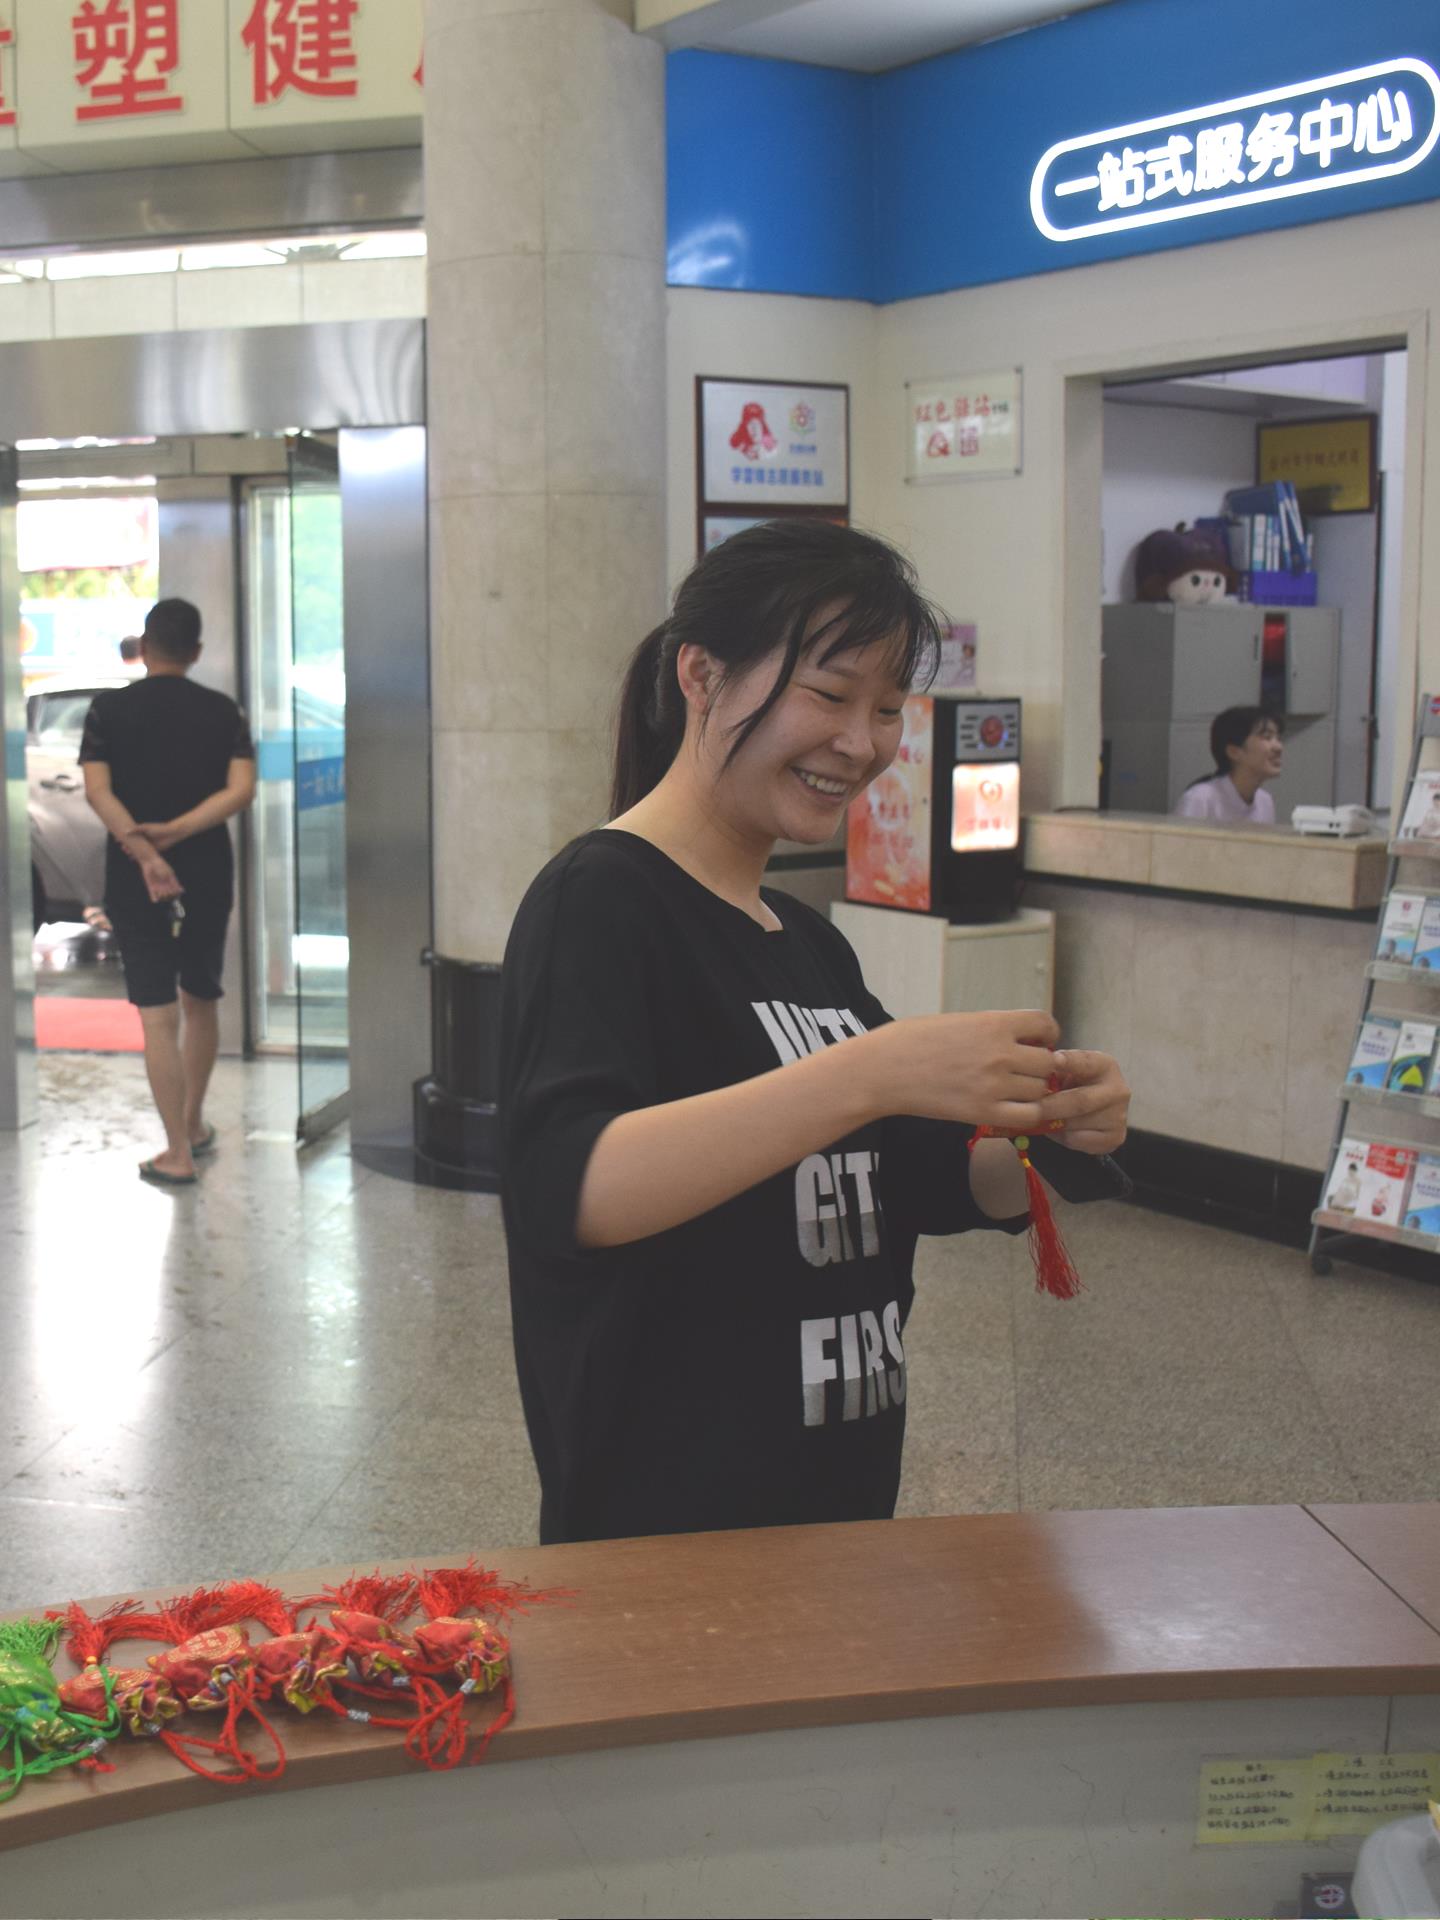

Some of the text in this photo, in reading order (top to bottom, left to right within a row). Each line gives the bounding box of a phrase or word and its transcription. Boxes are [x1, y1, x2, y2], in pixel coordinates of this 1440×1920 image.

[0, 0, 424, 126] 塑健
[1054, 87, 1412, 212] 一站式服务中心
[800, 1300, 906, 1427] FIRS
